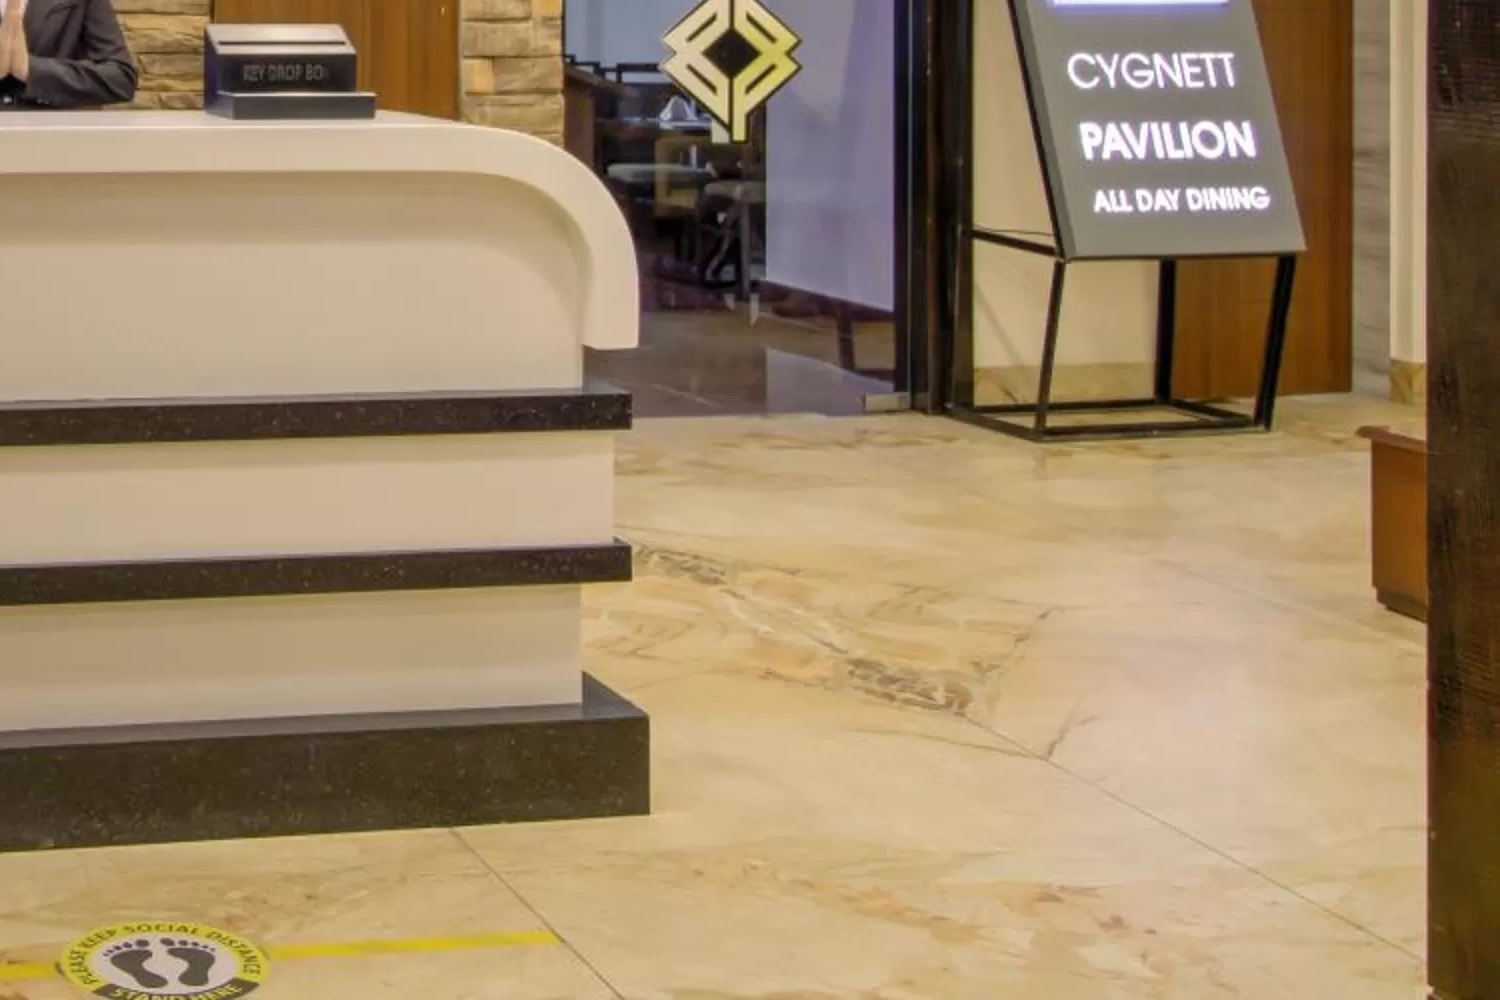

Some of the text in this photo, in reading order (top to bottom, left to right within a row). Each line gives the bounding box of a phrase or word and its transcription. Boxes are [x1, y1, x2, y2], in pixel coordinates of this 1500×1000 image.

[243, 63, 266, 82] KEY
[268, 63, 304, 82] DROP
[1067, 51, 1236, 89] CYGNETT
[1078, 119, 1258, 161] PAVILION
[1092, 186, 1272, 213] ALL DAY DINING
[68, 923, 262, 985] PLEASE KEEP SOCIAL DISTANCE
